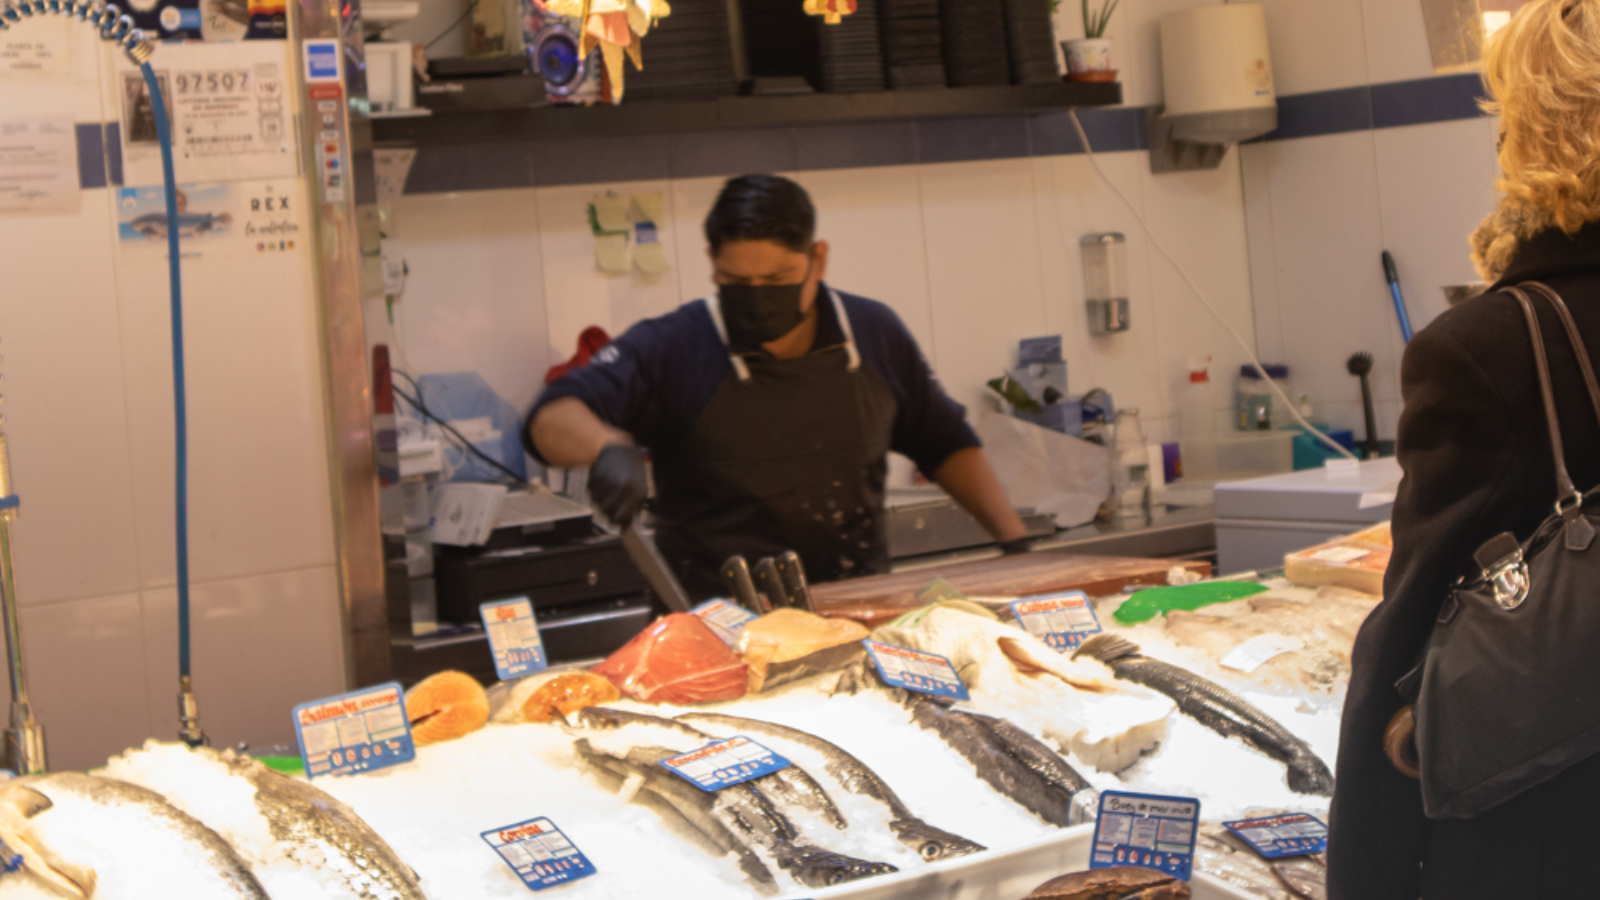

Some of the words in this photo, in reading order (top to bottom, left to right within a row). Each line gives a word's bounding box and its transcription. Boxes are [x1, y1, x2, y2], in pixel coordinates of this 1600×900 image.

[175, 72, 249, 94] 97507
[251, 197, 289, 211] REX
[1110, 798, 1136, 815] Buey
[498, 823, 545, 844] Corvina
